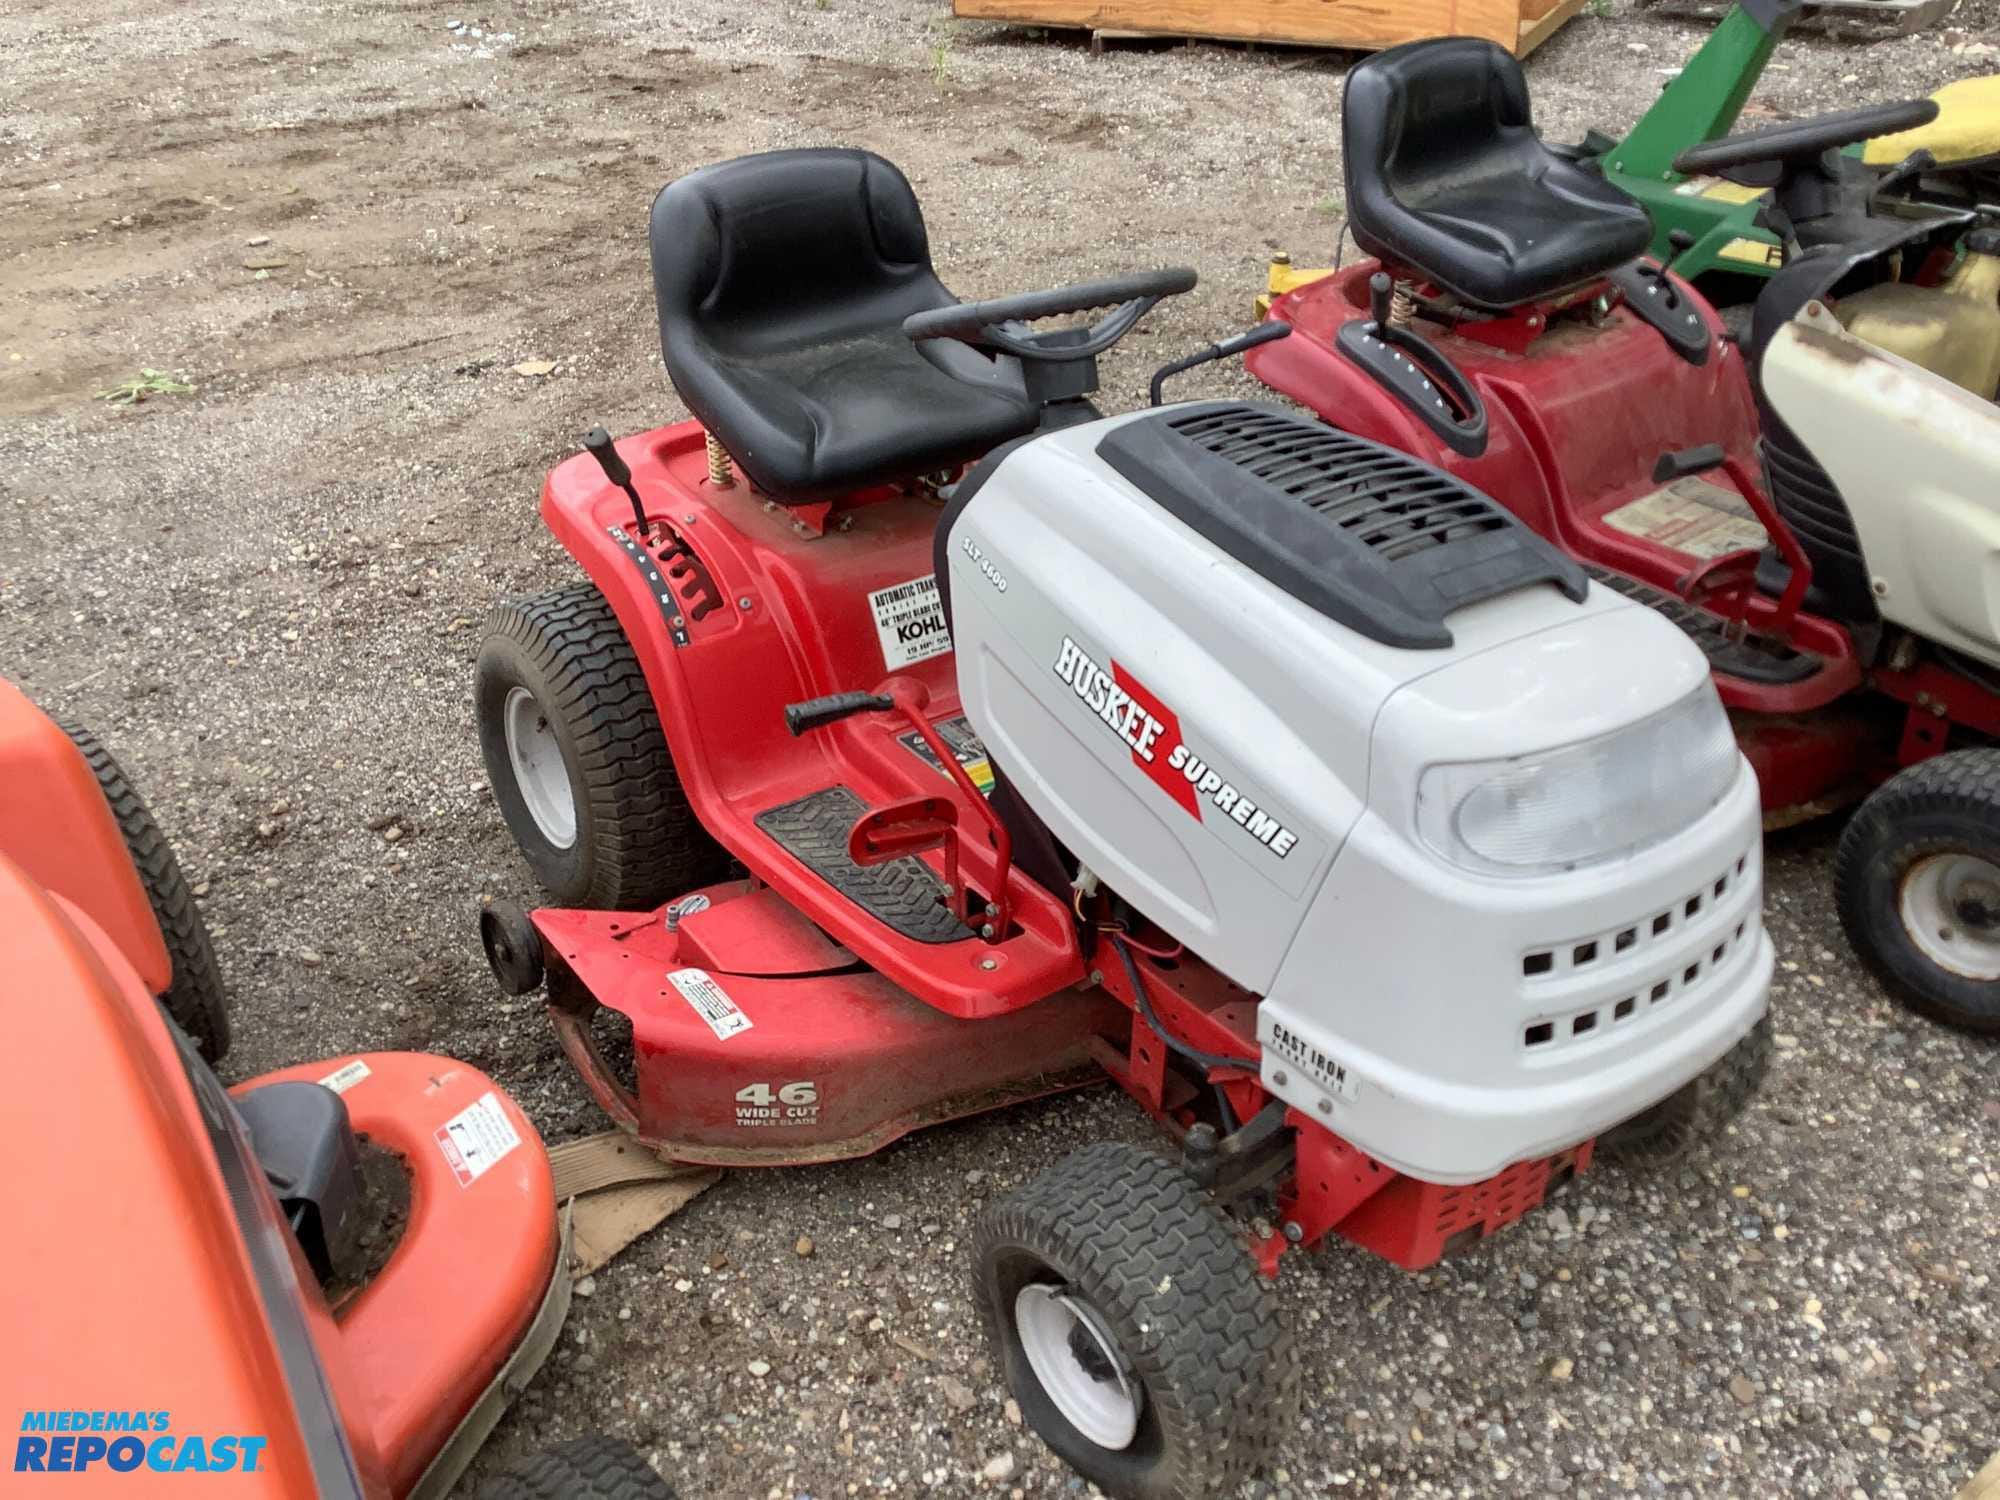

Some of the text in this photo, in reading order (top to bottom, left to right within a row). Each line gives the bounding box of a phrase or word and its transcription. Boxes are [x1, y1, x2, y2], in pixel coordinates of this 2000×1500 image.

[874, 584, 916, 608] AUTOMATIC
[1053, 635, 1165, 763] HUSKEE
[1167, 744, 1299, 859] SUPREME
[1273, 1023, 1307, 1057] CAST
[1311, 1049, 1346, 1083] IRON
[735, 1081, 817, 1106] 46
[736, 1105, 820, 1118] WIDE CUT
[736, 1118, 776, 1127] TRIPLE
